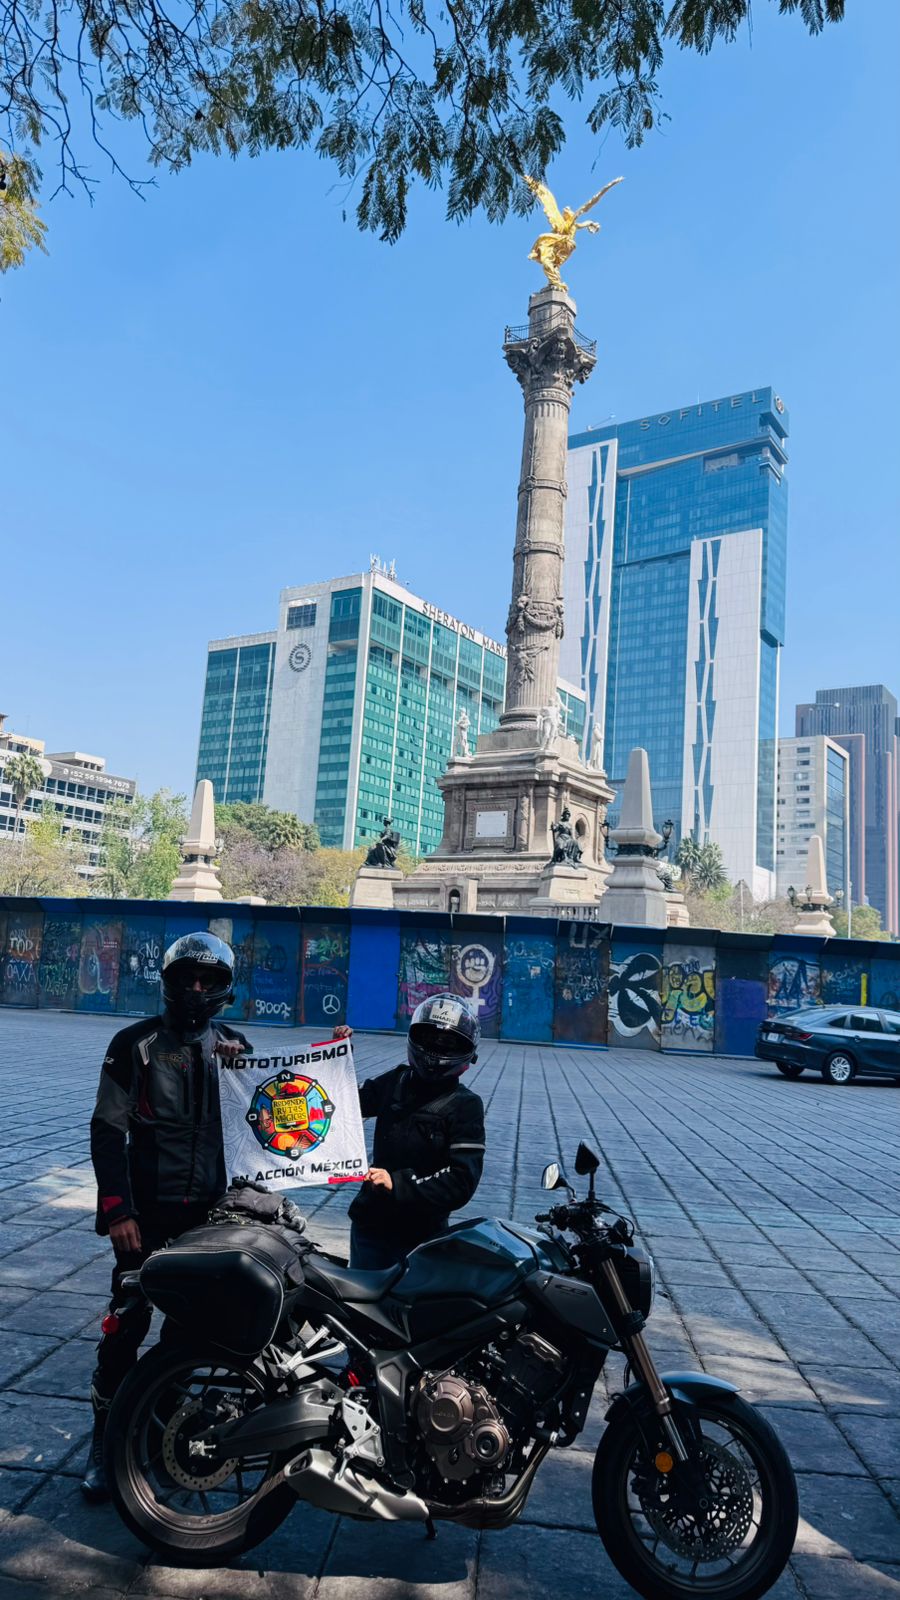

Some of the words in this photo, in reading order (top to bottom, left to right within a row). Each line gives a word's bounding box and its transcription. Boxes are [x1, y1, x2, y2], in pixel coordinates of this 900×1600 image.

[639, 391, 764, 431] SOFITEL
[422, 602, 476, 641] SHERATON
[221, 1044, 348, 1070] MOTOTURISMO
[324, 1104, 333, 1112] E
[290, 1149, 299, 1157] S
[255, 1163, 305, 1182] ACCIÓN
[311, 1158, 362, 1173] MÉXICO
